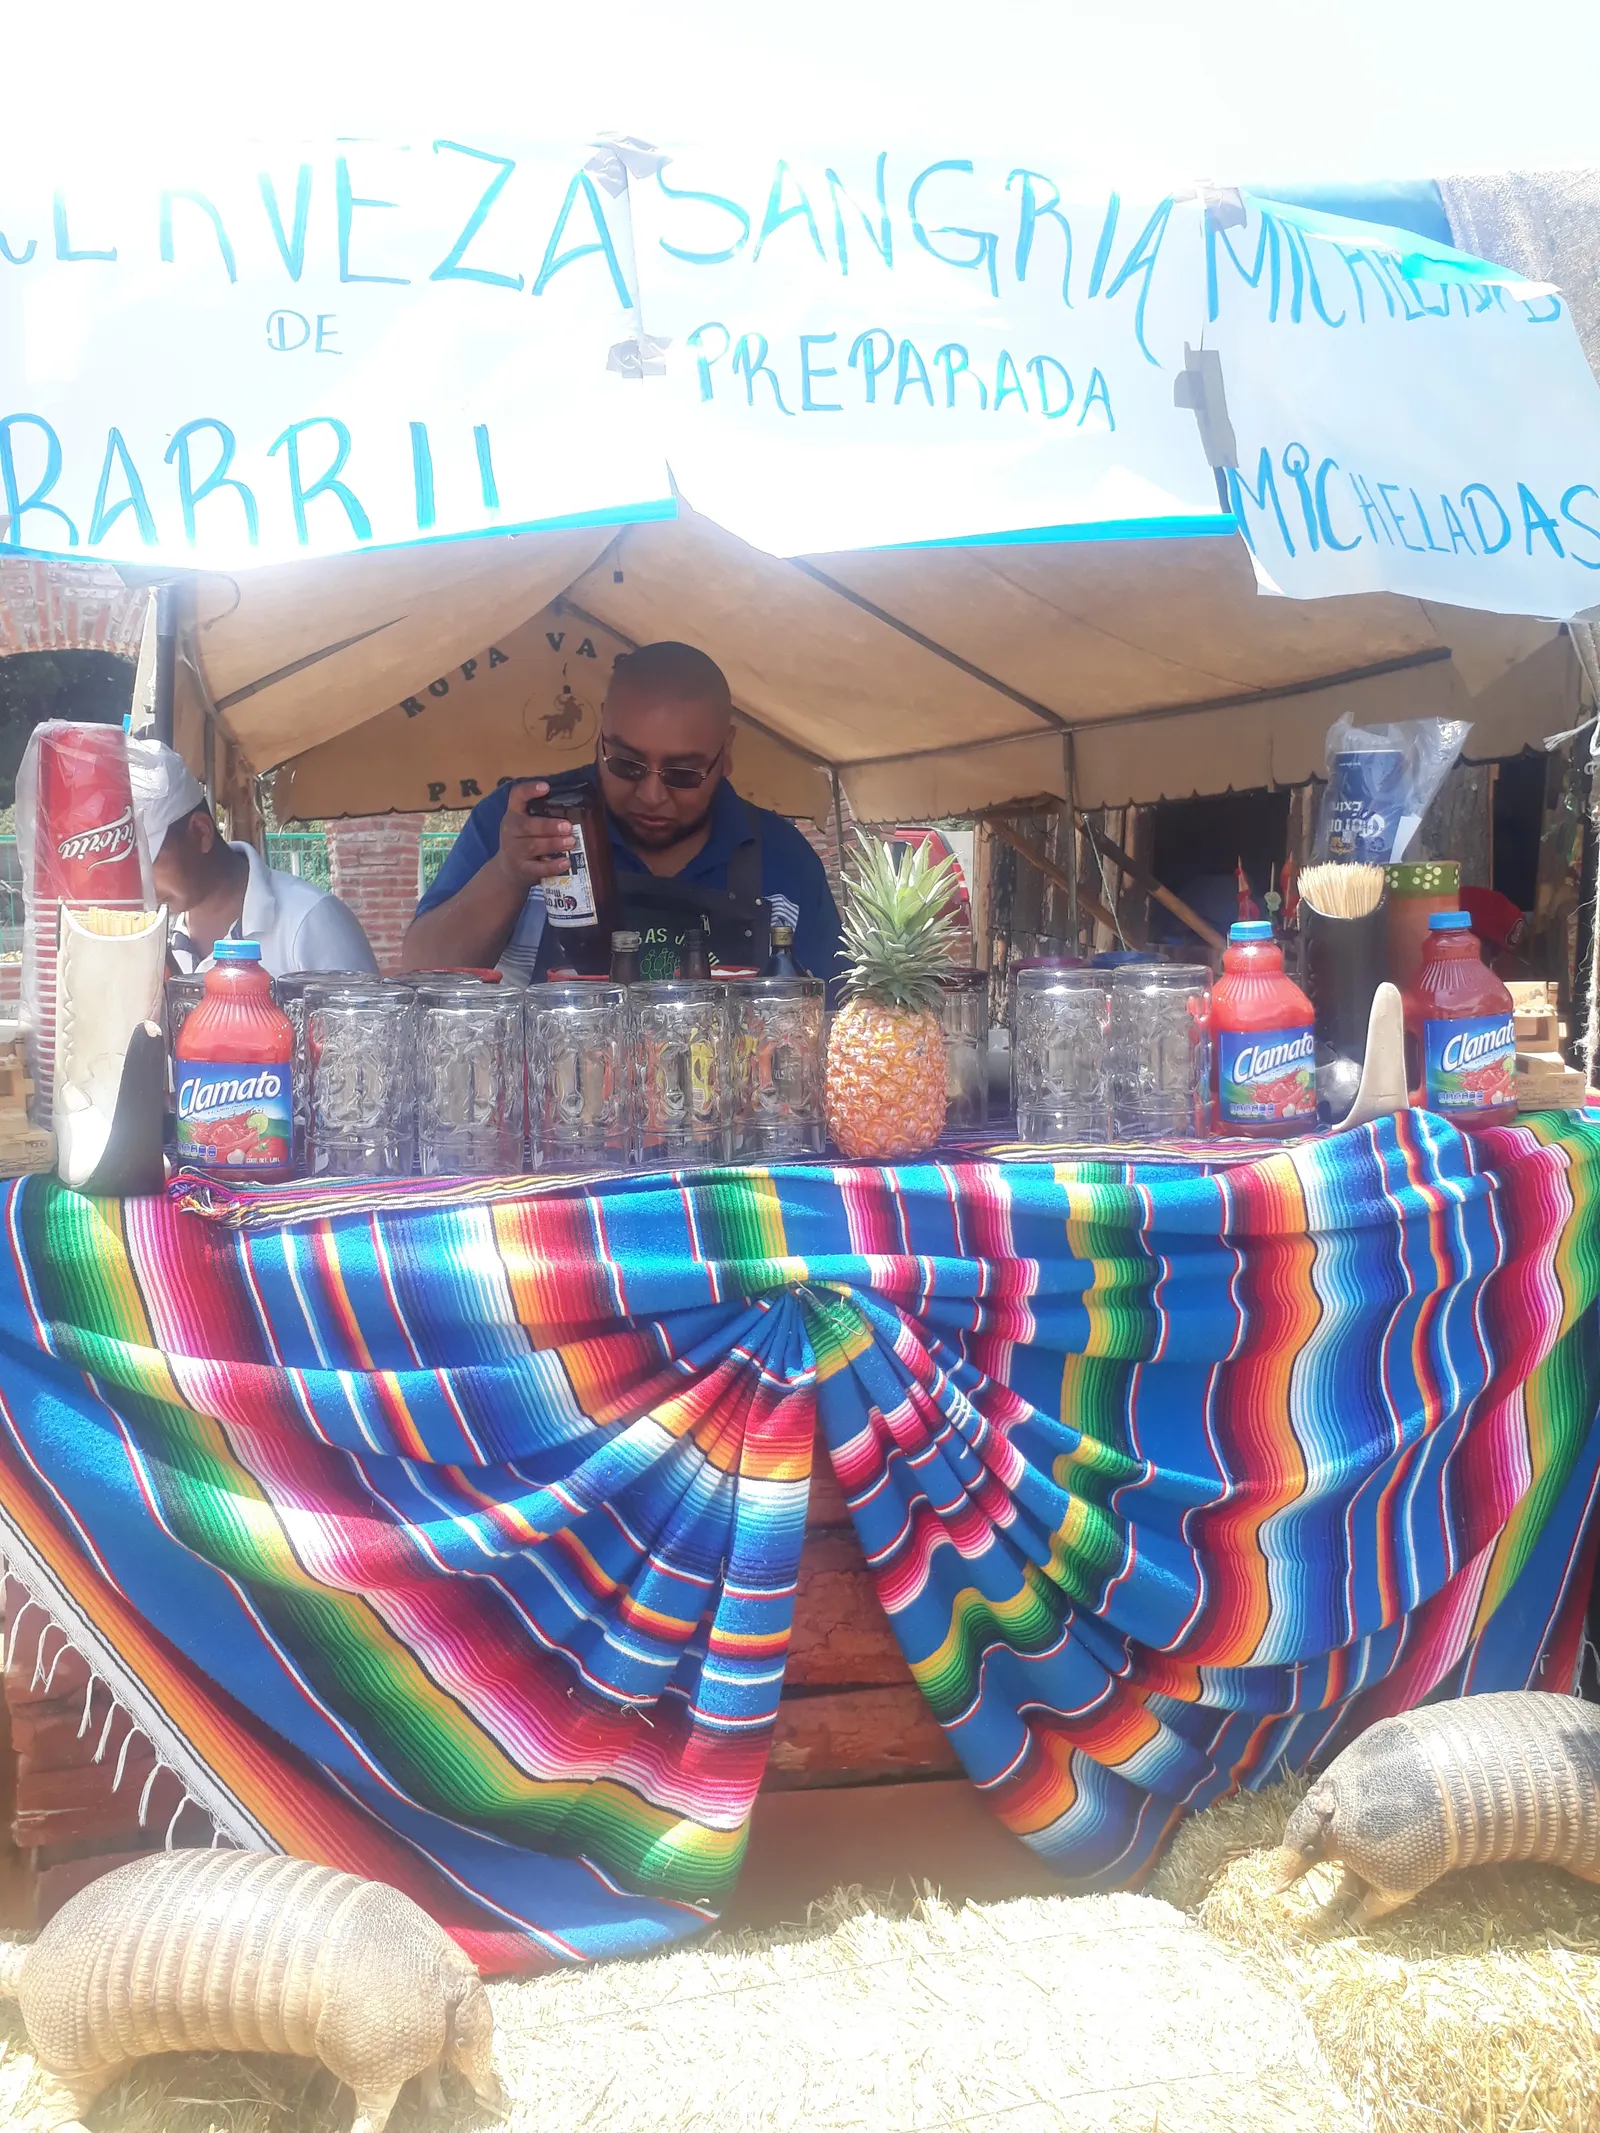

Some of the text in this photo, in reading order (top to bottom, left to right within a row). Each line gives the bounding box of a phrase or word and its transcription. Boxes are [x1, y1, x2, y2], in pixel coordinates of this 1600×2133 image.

[656, 151, 1166, 370] SANGRIA
[266, 309, 344, 355] DE
[687, 321, 1117, 432] PREPARADA
[400, 631, 632, 719] ROPA VA
[426, 775, 515, 803] PR
[1330, 812, 1386, 839] Coro
[1231, 1031, 1315, 1085] Clamato
[178, 1070, 282, 1120] Clamato
